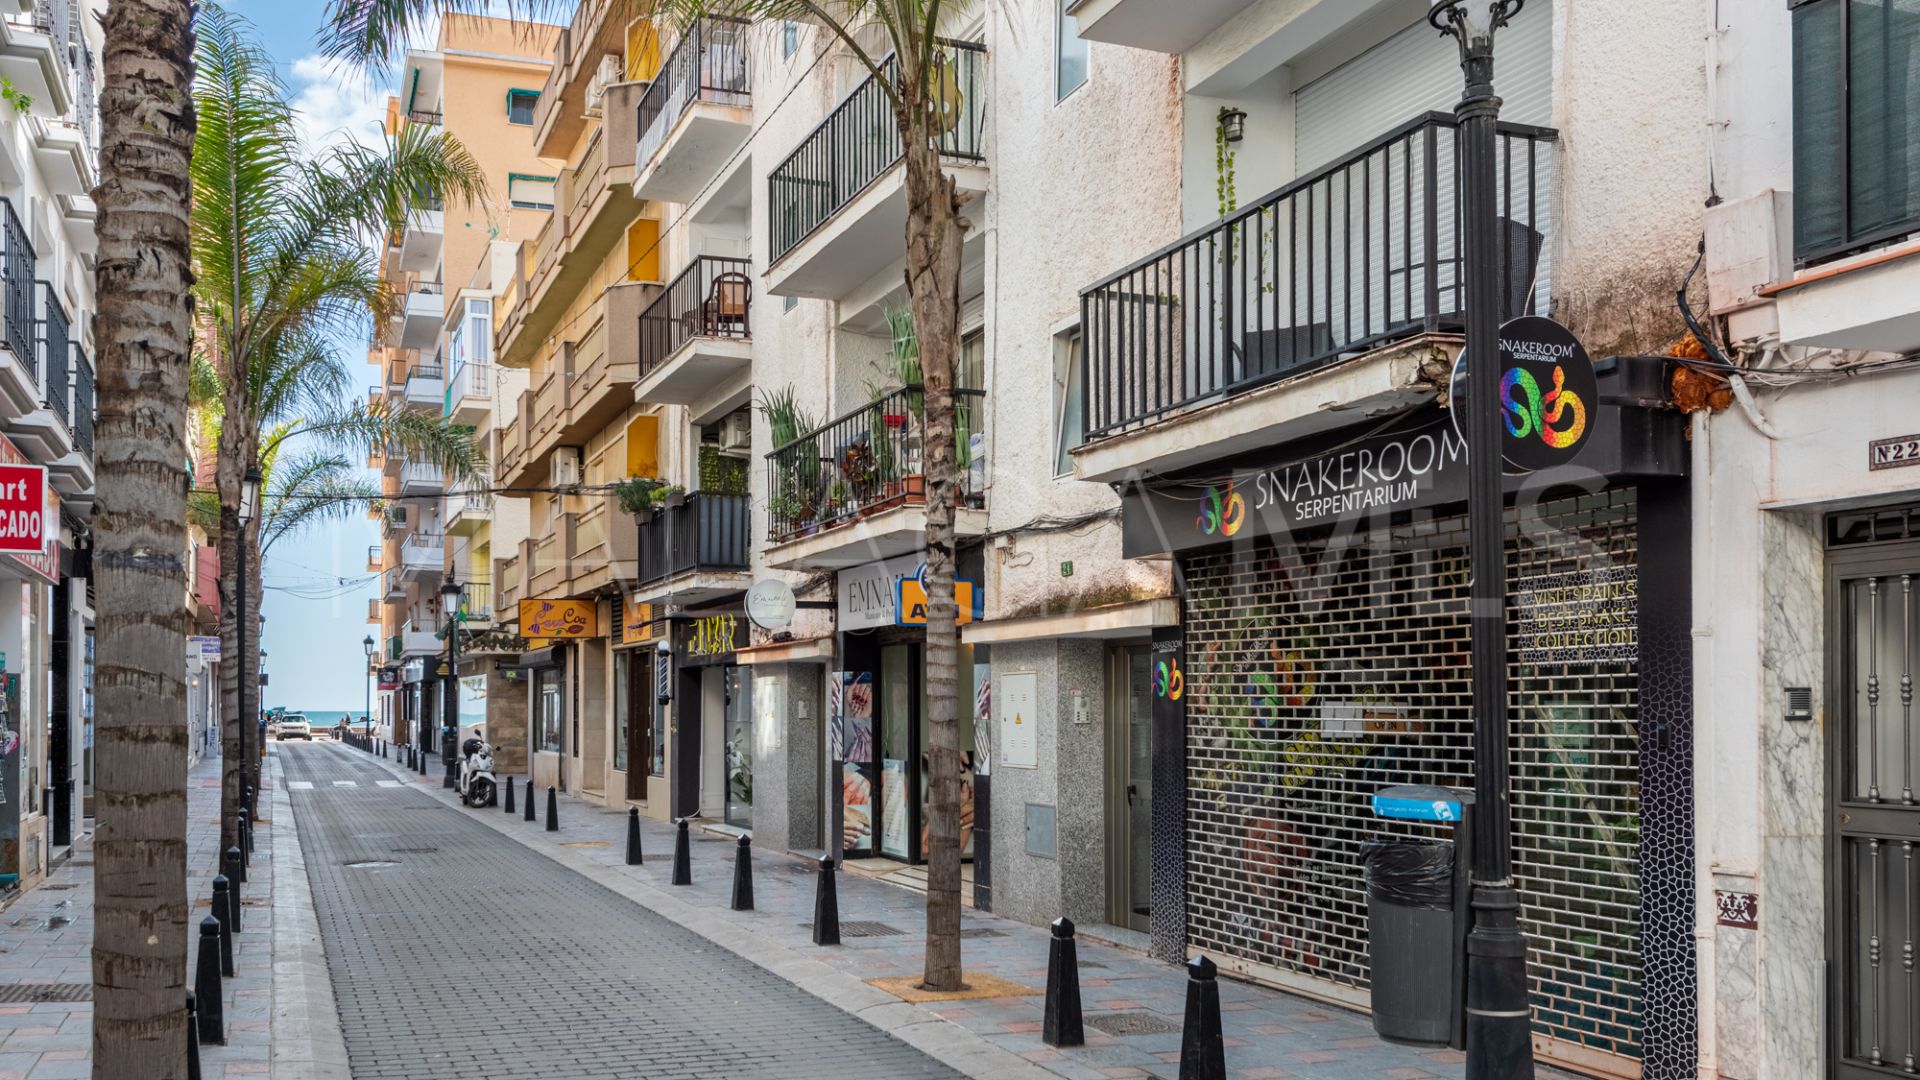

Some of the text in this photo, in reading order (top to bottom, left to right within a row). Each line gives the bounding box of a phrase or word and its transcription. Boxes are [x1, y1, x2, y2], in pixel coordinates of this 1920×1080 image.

[1499, 339, 1574, 358] SNAKEROOM
[1513, 351, 1556, 362] SERPENTARIUM
[1256, 429, 1469, 509] SNAKEROOM
[1295, 480, 1417, 520] SERPENTARIUM
[848, 573, 904, 613] EMNA
[1534, 588, 1569, 606] VISIT
[1538, 606, 1631, 628] BEST SNAKE
[1536, 629, 1634, 648] COLLECTION
